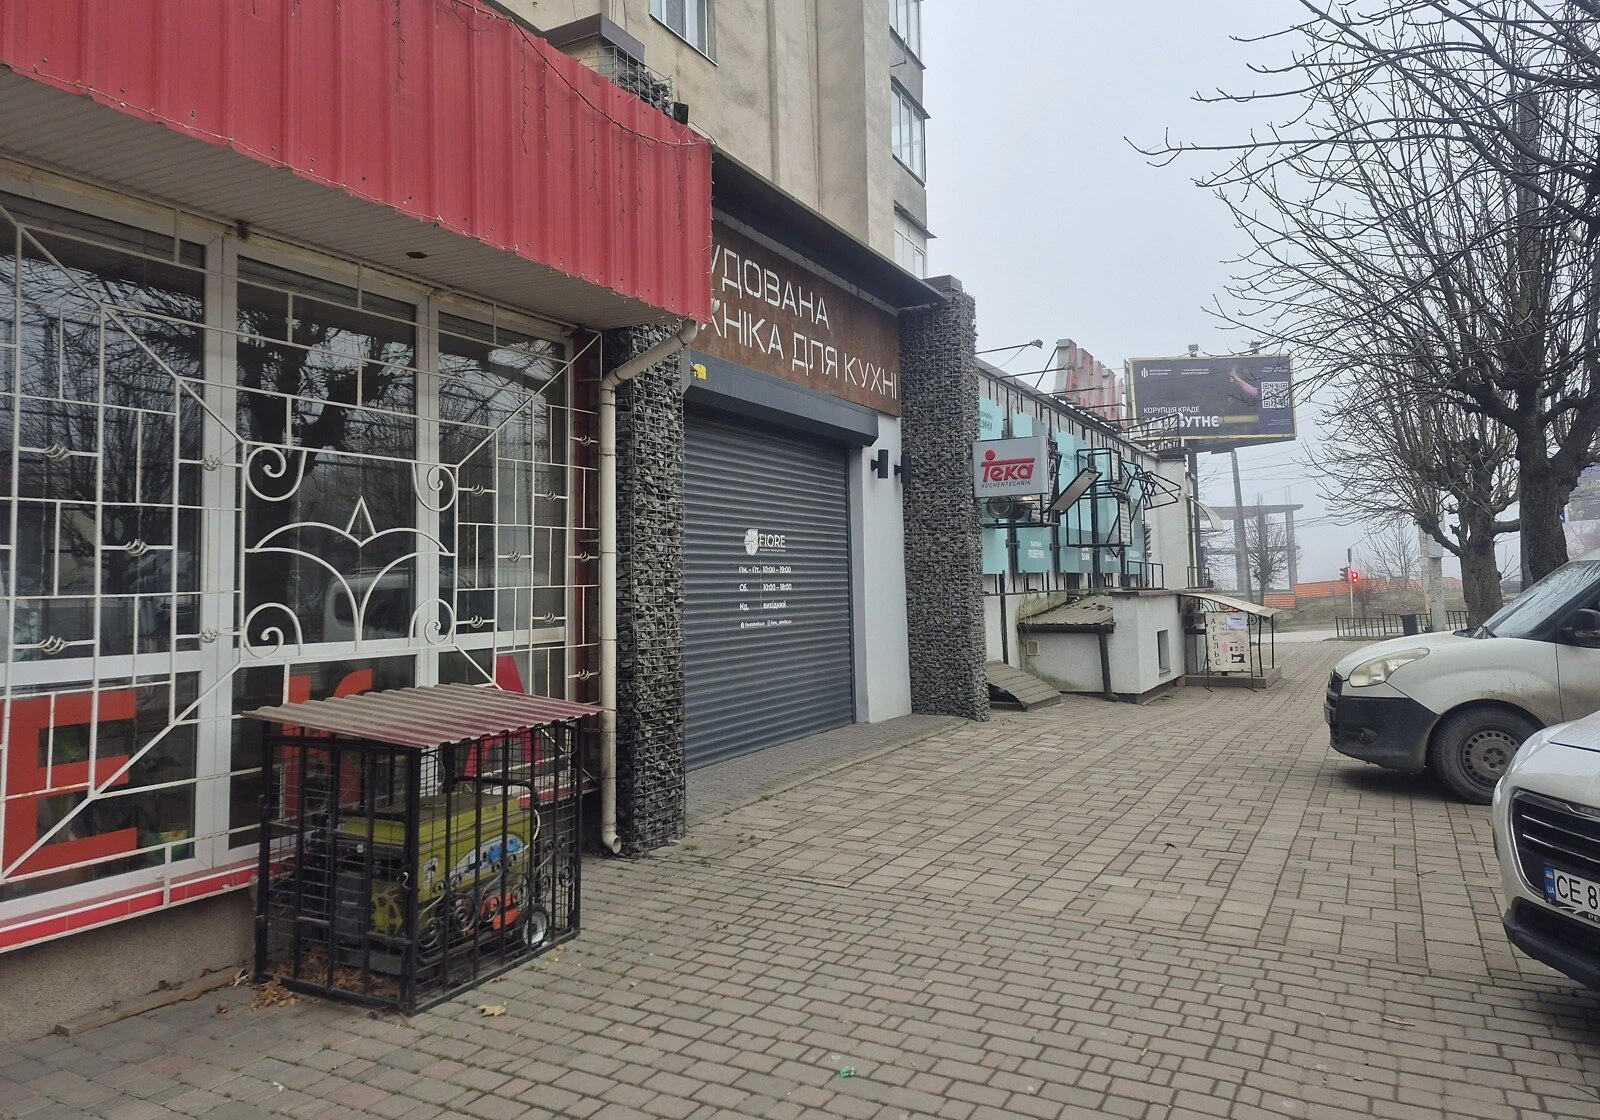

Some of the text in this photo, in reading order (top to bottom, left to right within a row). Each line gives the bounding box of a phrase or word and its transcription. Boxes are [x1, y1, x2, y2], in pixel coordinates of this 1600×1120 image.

[791, 331, 839, 379] ДЛЯ
[844, 352, 898, 400] КУХНІ
[1178, 405, 1201, 413] КРАДЕ
[758, 533, 786, 548] FIORE
[762, 565, 776, 574] 10:00
[762, 583, 776, 591] 10:00
[1210, 617, 1221, 666] АТЕЛЬЄ
[1547, 886, 1555, 895] UA
[1556, 874, 1583, 906] CE
